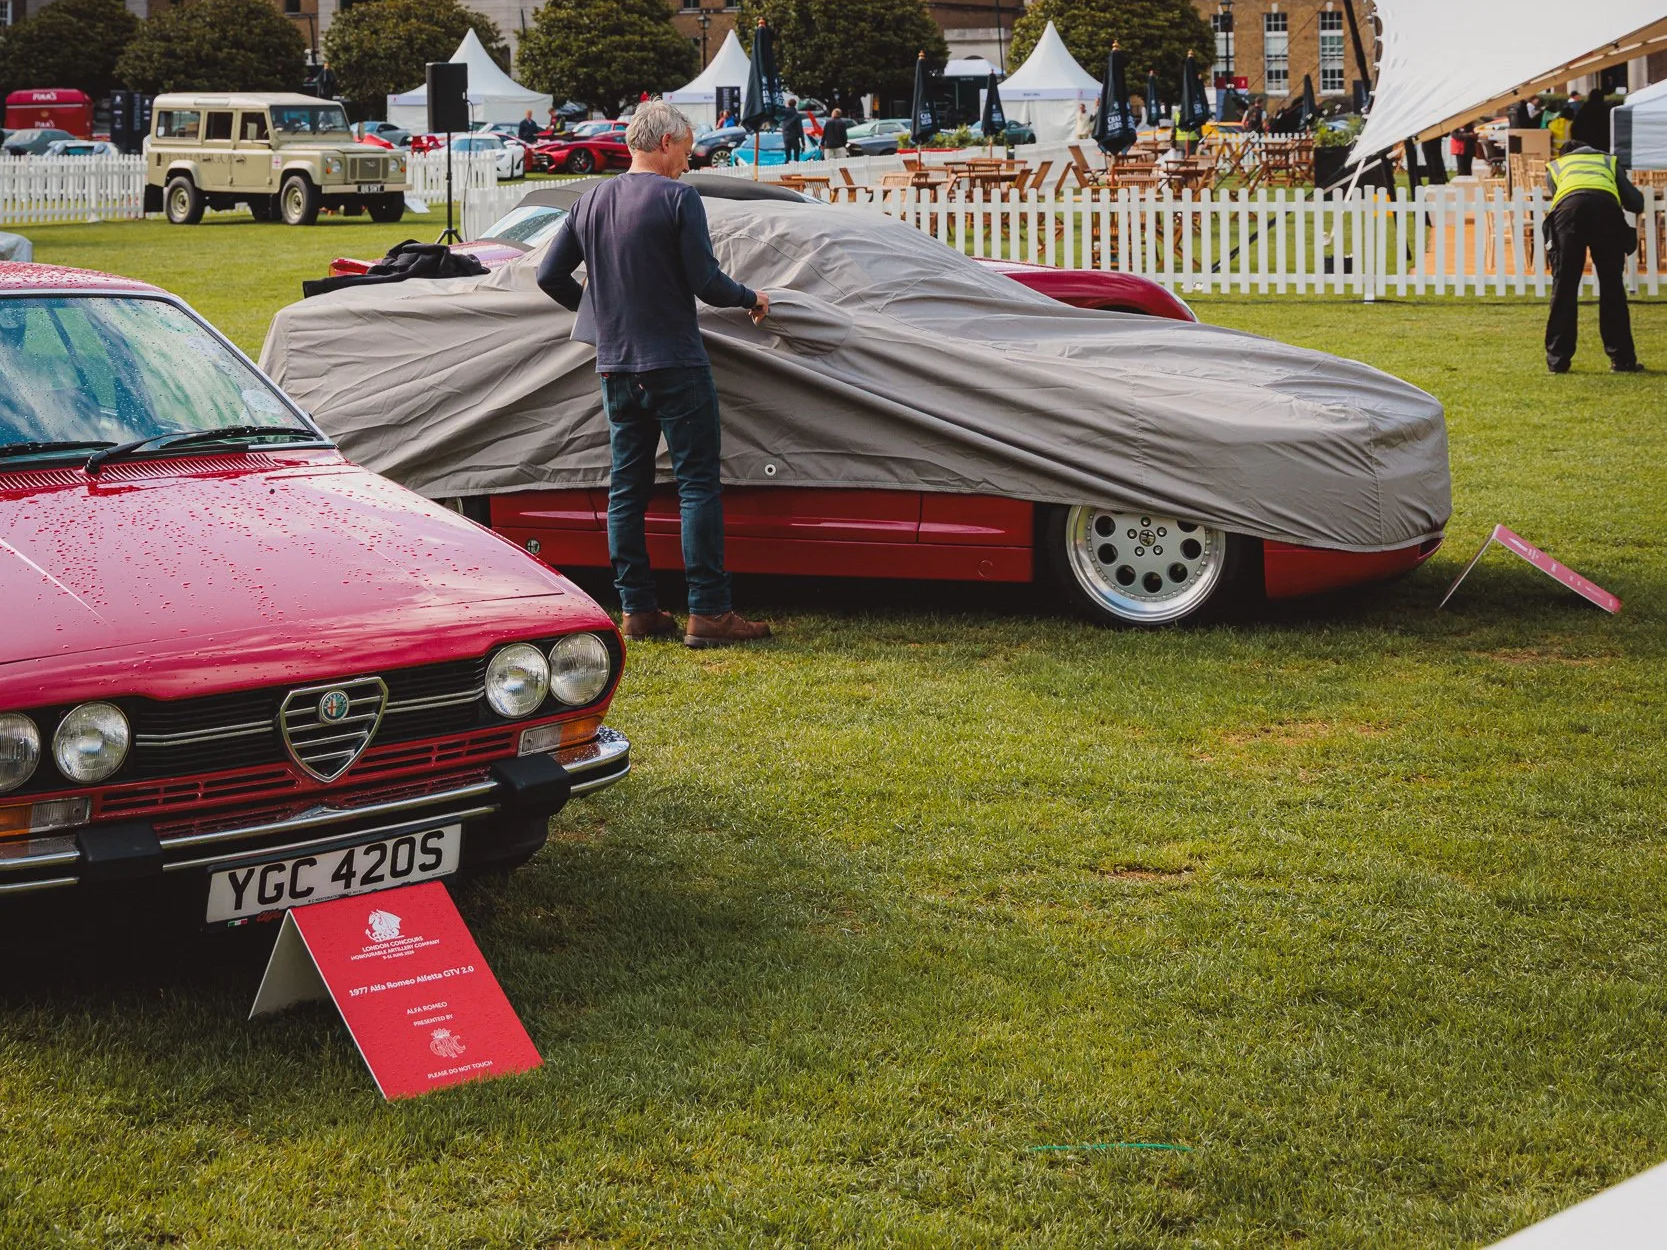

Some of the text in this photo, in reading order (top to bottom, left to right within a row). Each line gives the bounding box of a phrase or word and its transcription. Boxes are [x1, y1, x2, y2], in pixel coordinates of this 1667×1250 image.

[227, 830, 445, 911] YGC 420S
[351, 939, 440, 961] HONOURABLE ARTILLERY COMPANY
[362, 936, 424, 953] LONDON CONCOURS
[349, 965, 475, 997] 1977 Alfa Romeo Alfetta GTV 2.0
[406, 1001, 448, 1015] ALFA ROMEO
[413, 1015, 445, 1027] PRESENTED
[427, 1060, 493, 1079] PLEASE DO NOT TOUCH
